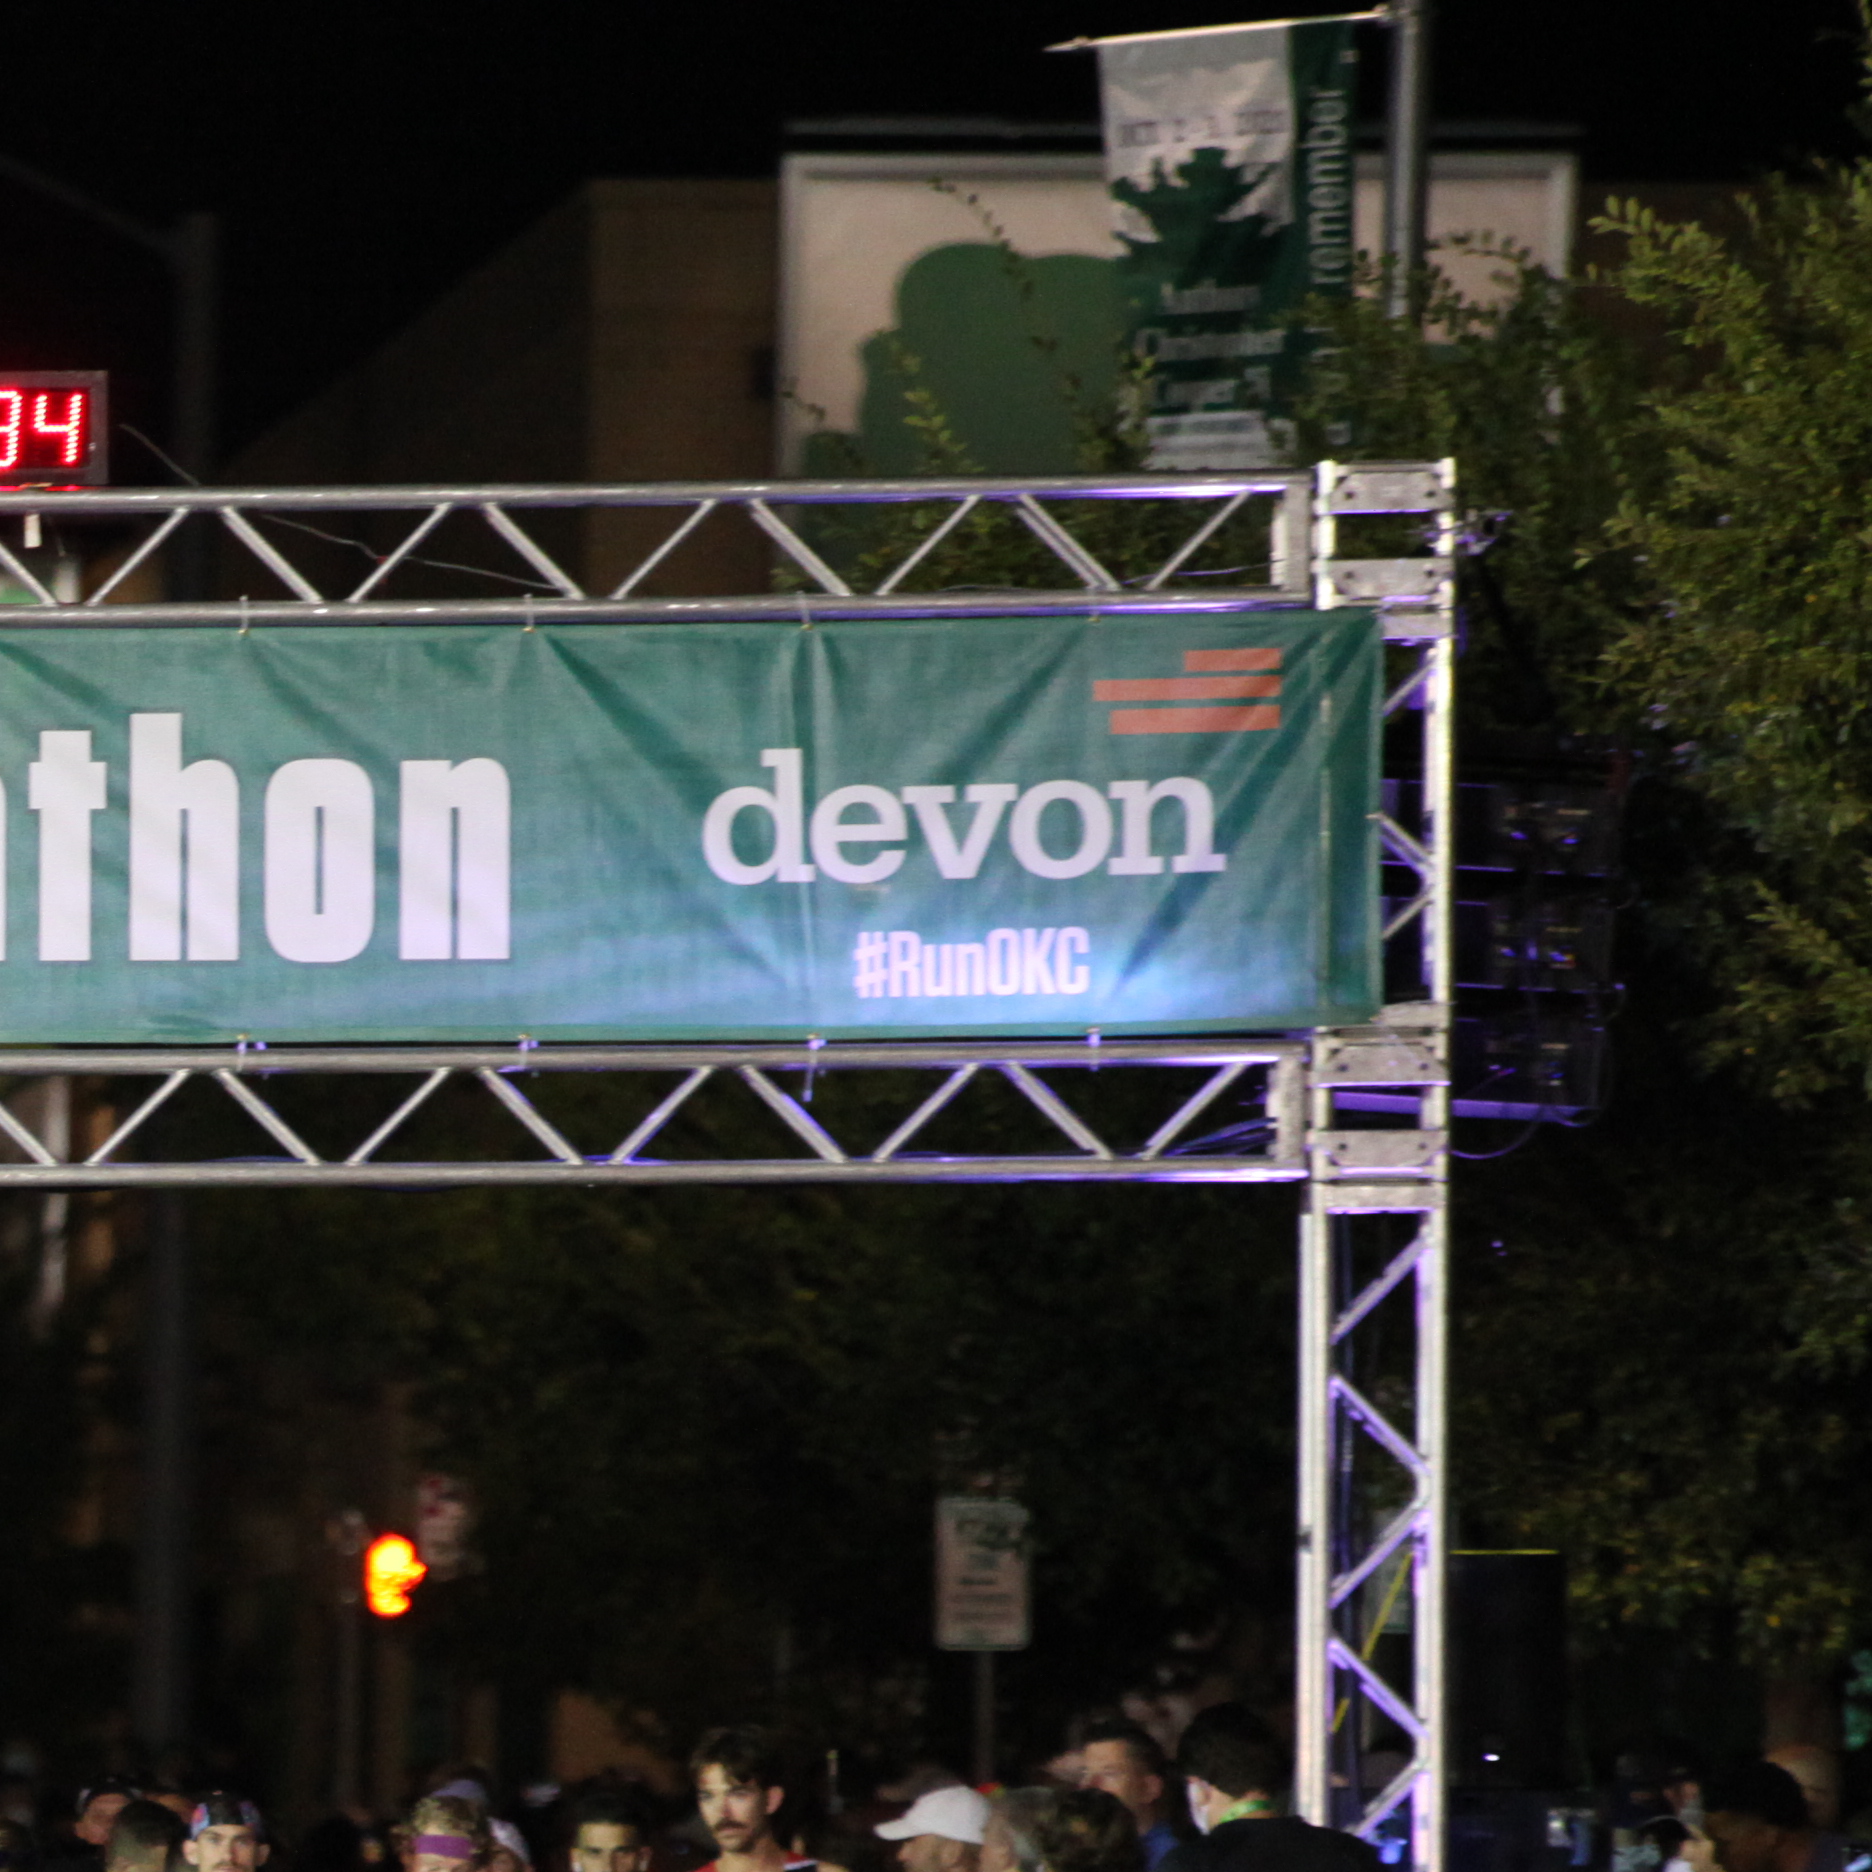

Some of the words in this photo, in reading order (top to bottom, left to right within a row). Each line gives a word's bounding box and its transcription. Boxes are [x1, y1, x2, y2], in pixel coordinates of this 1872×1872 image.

[1306, 86, 1350, 285] remember
[702, 748, 1226, 885] devon
[853, 926, 1090, 998] #RunOKC
